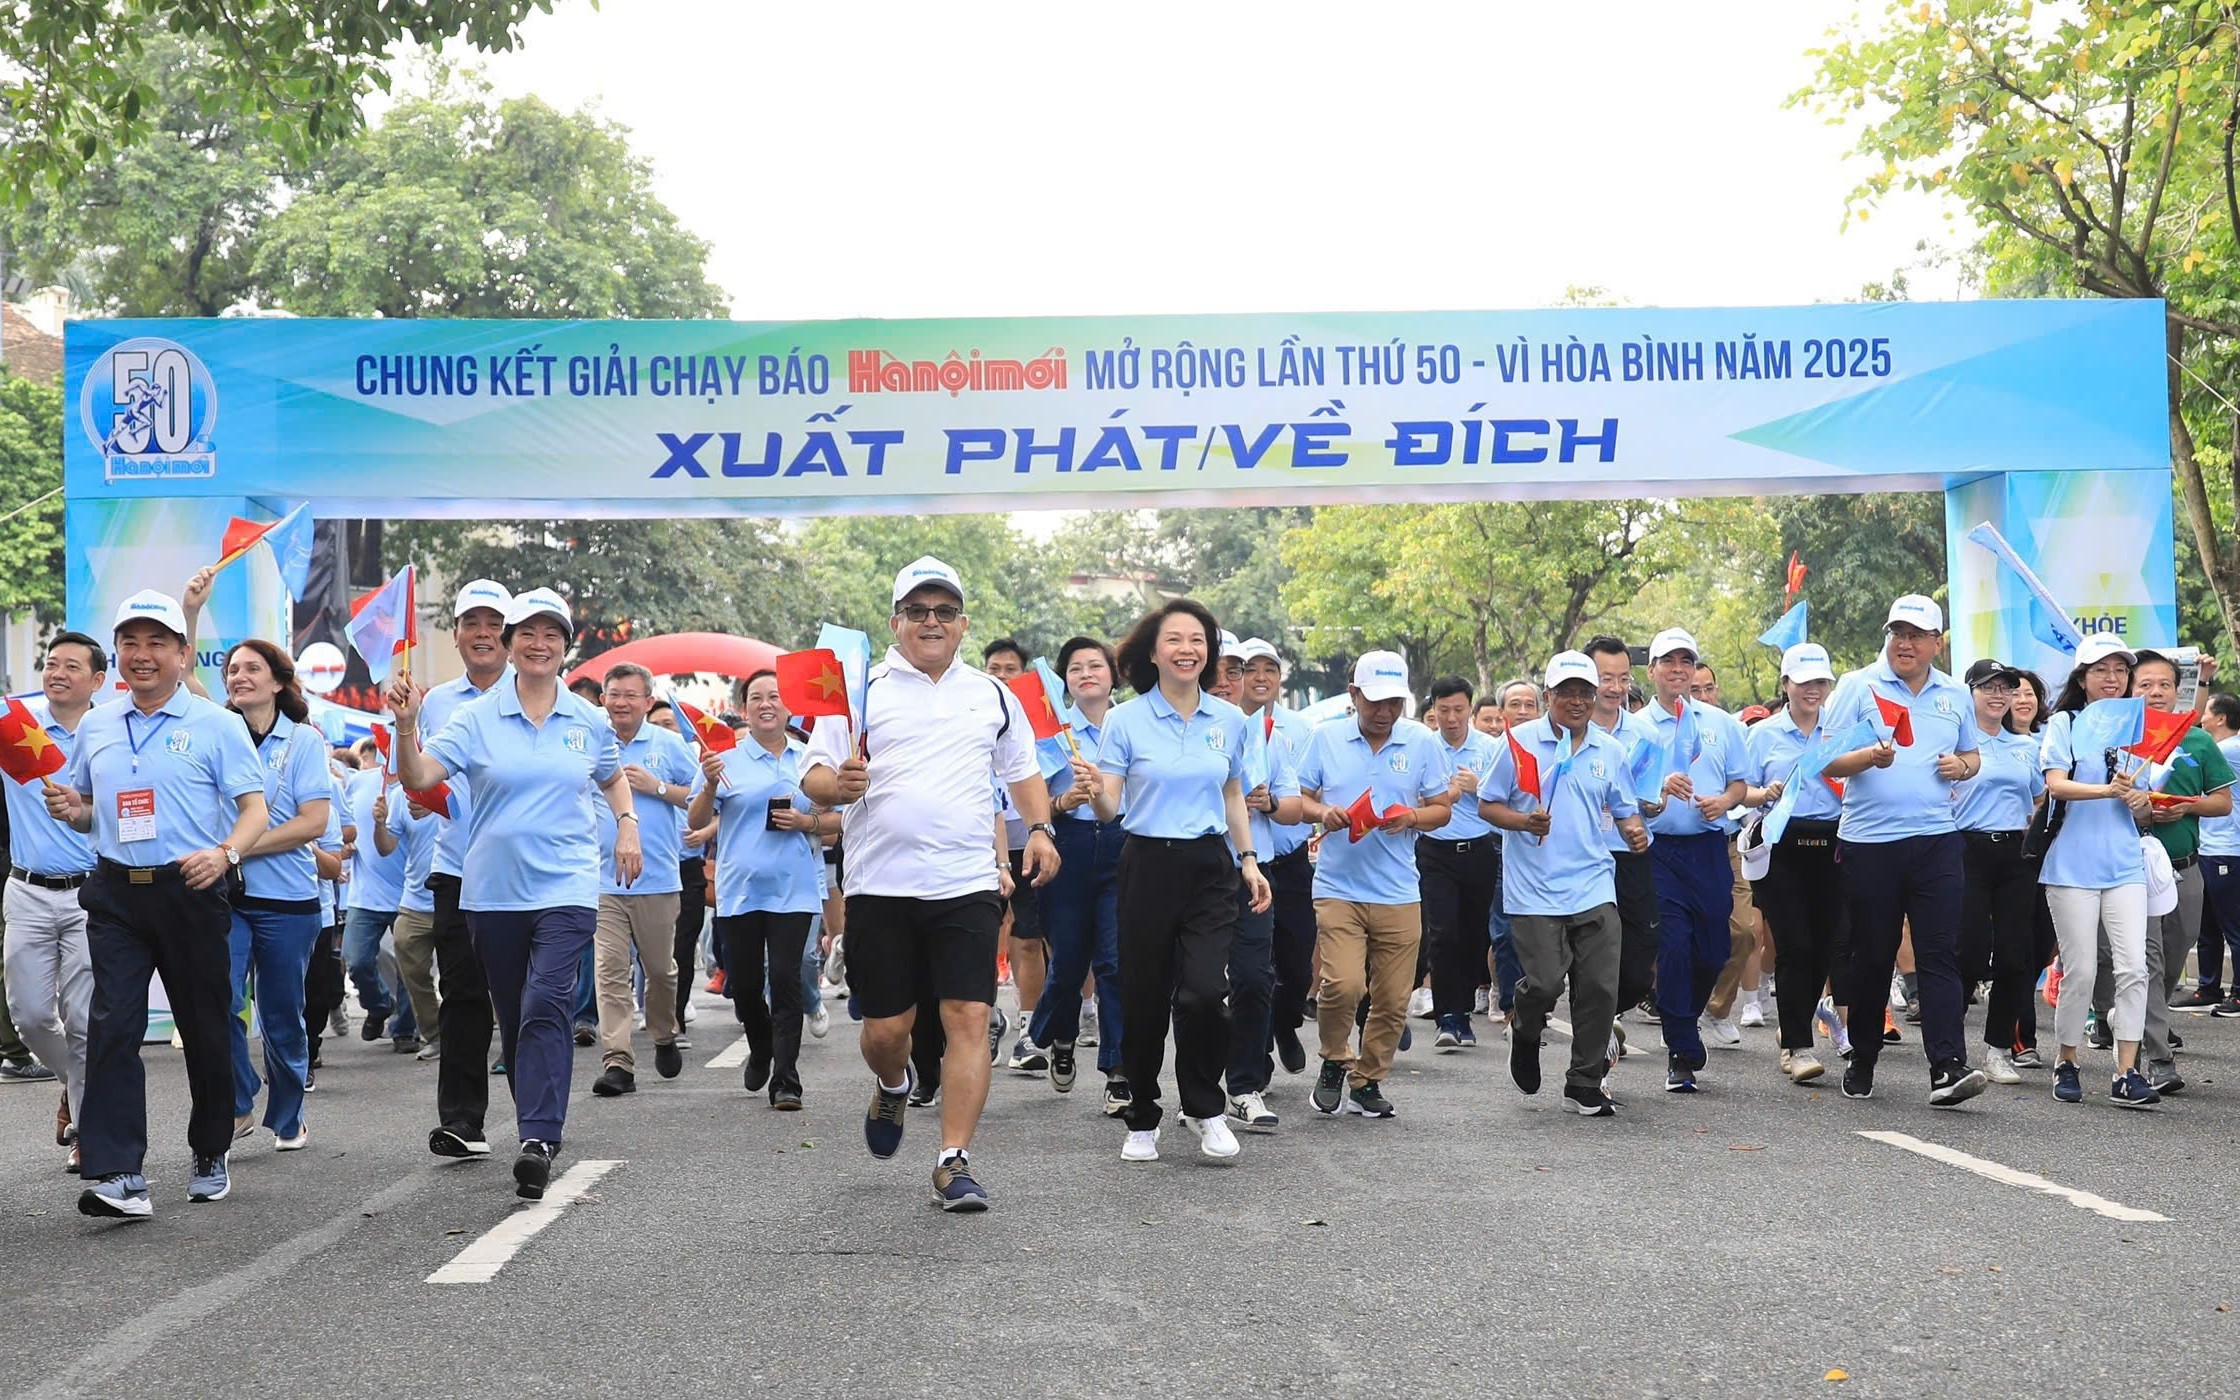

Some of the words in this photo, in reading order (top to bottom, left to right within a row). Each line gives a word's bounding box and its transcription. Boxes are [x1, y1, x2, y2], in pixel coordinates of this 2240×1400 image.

[113, 349, 191, 454] 50
[356, 354, 477, 396] CHUNG
[491, 344, 557, 396] KẾT
[568, 344, 637, 396] GIẢI
[650, 355, 746, 404] CHẠY
[758, 347, 829, 395] BÁO
[1086, 337, 1140, 390] MỞ
[1152, 341, 1246, 397] RỘNG
[1258, 334, 1325, 389] LẦN
[1335, 343, 1407, 386] THỨ
[1416, 344, 1461, 384] 50
[1496, 334, 1530, 383] VÌ
[1542, 334, 1612, 382] HÒA
[1622, 334, 1702, 381] BÌNH
[1715, 332, 1792, 379] NĂM
[1803, 337, 1892, 378] 2025
[650, 405, 905, 478] XUẤT
[1385, 402, 1619, 465] ĐÍCH
